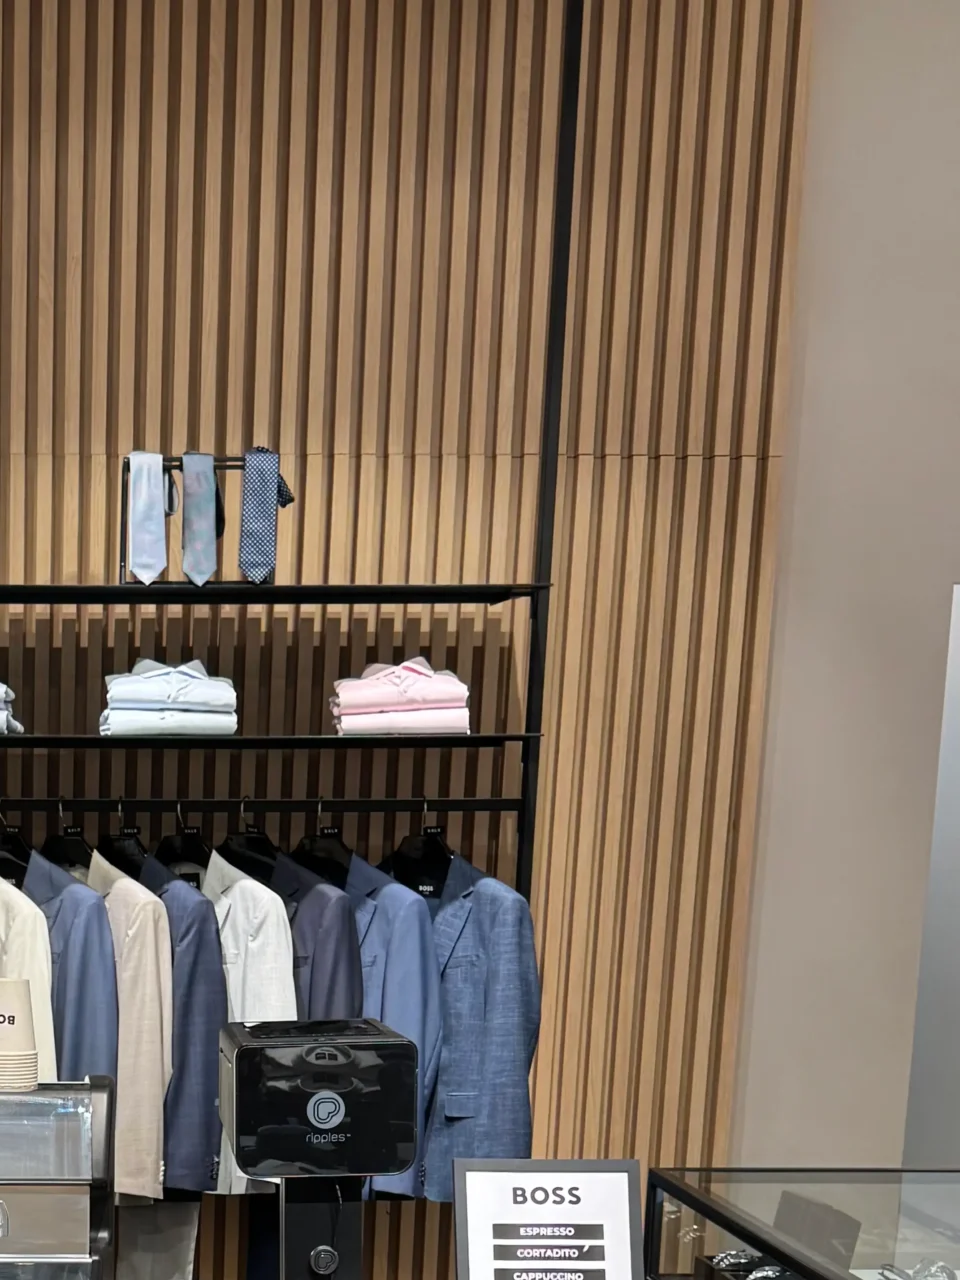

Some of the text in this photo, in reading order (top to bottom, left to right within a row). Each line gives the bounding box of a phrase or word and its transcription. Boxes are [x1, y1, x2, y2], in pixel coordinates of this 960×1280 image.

[512, 1187, 581, 1205] BOSS
[519, 1226, 575, 1236] ESPRESSO
[516, 1248, 579, 1258] CORTADITO
[513, 1272, 584, 1280] CAPPUCCINO
